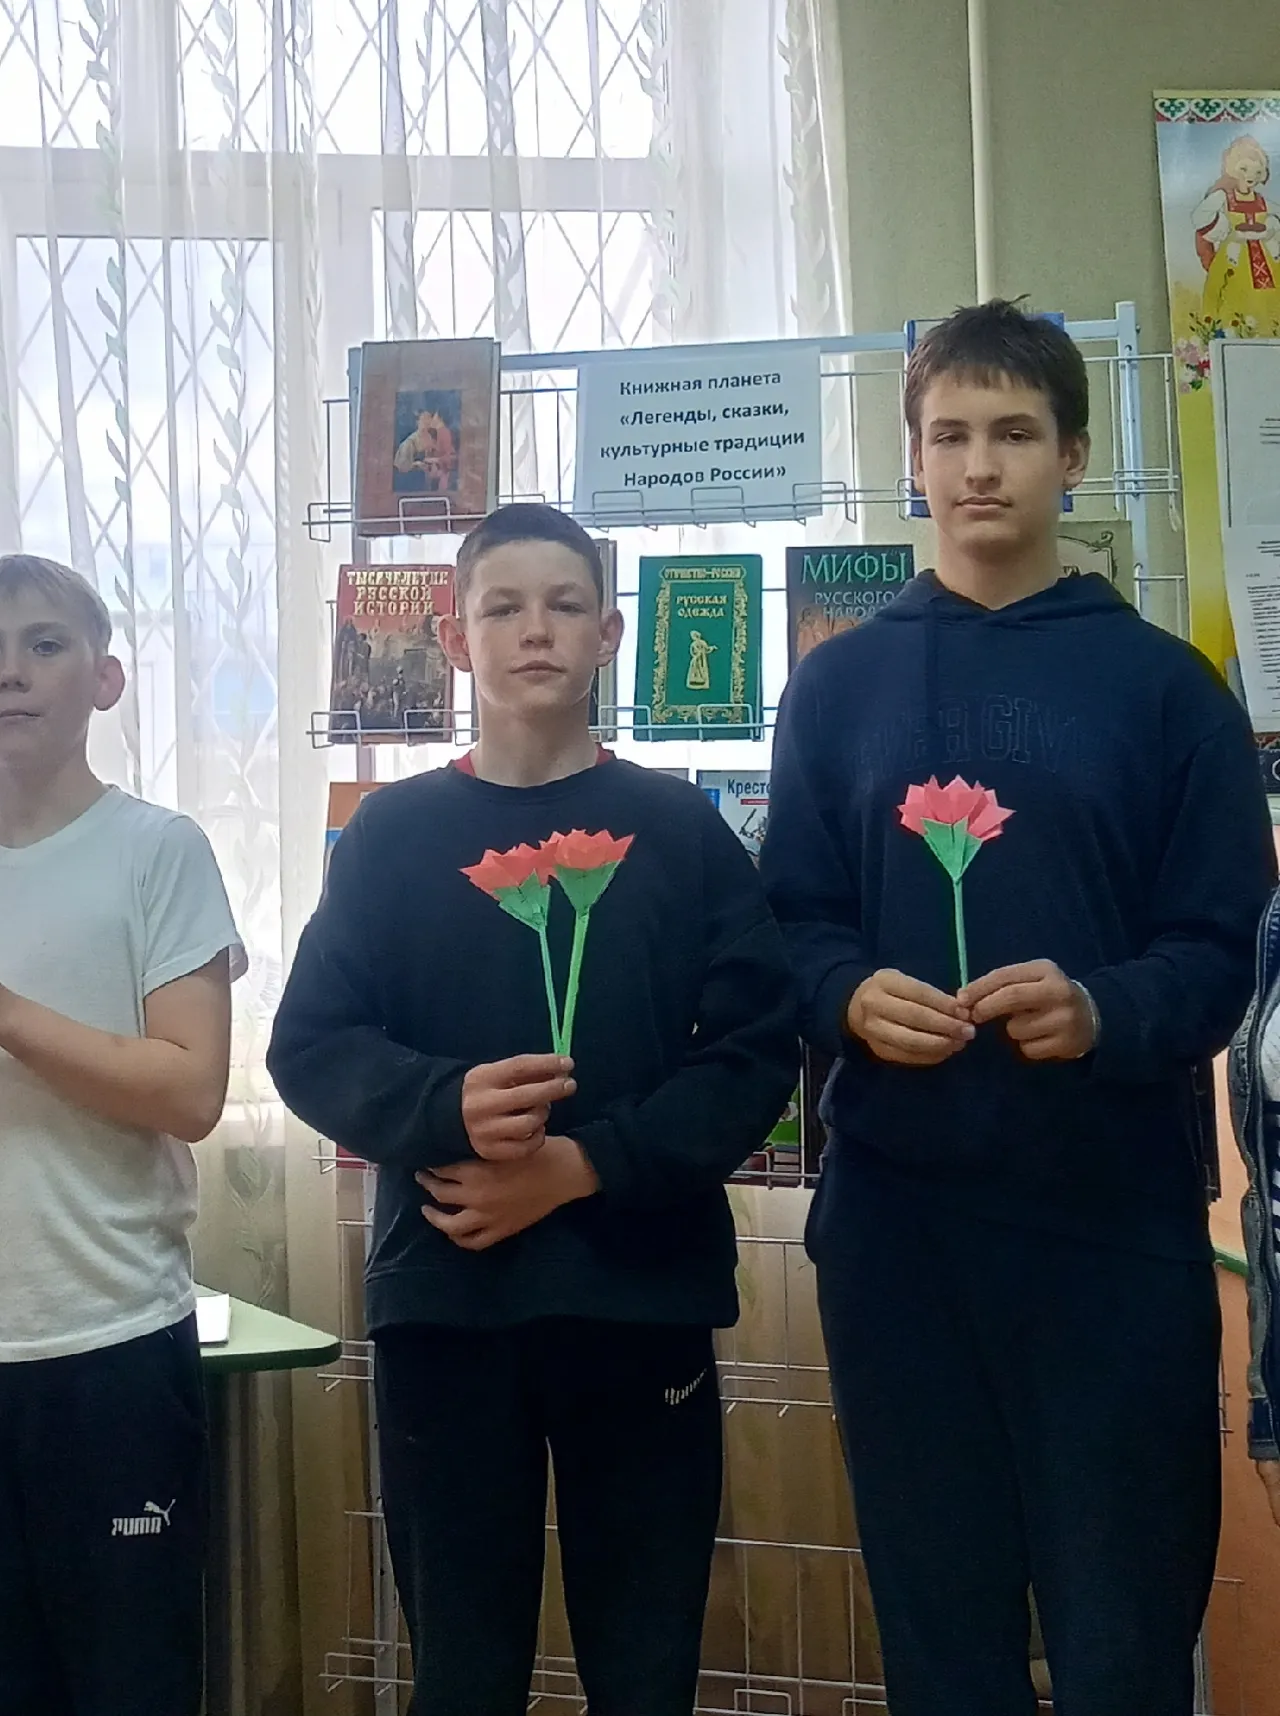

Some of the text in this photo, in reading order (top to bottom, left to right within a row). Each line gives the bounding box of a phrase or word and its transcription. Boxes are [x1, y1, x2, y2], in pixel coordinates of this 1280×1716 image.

[619, 372, 781, 396] Книжная планета
[620, 402, 789, 426] «Легенды, сказки,
[600, 431, 805, 460] культурные традиции
[624, 464, 786, 487] Народов России»
[802, 552, 906, 584] МИФЫ
[346, 571, 449, 586] ТЫСЯЧЕЛЕТИЕ
[356, 584, 432, 600] РУССКОЙ
[814, 590, 896, 605] РУССКОГО
[354, 601, 435, 616] ИСТОРИИ
[676, 595, 727, 607] РУССКАЯ
[677, 608, 725, 619] ОДЕЖДА
[823, 605, 885, 619] НАРОД
[111, 1516, 162, 1536] PUMA
